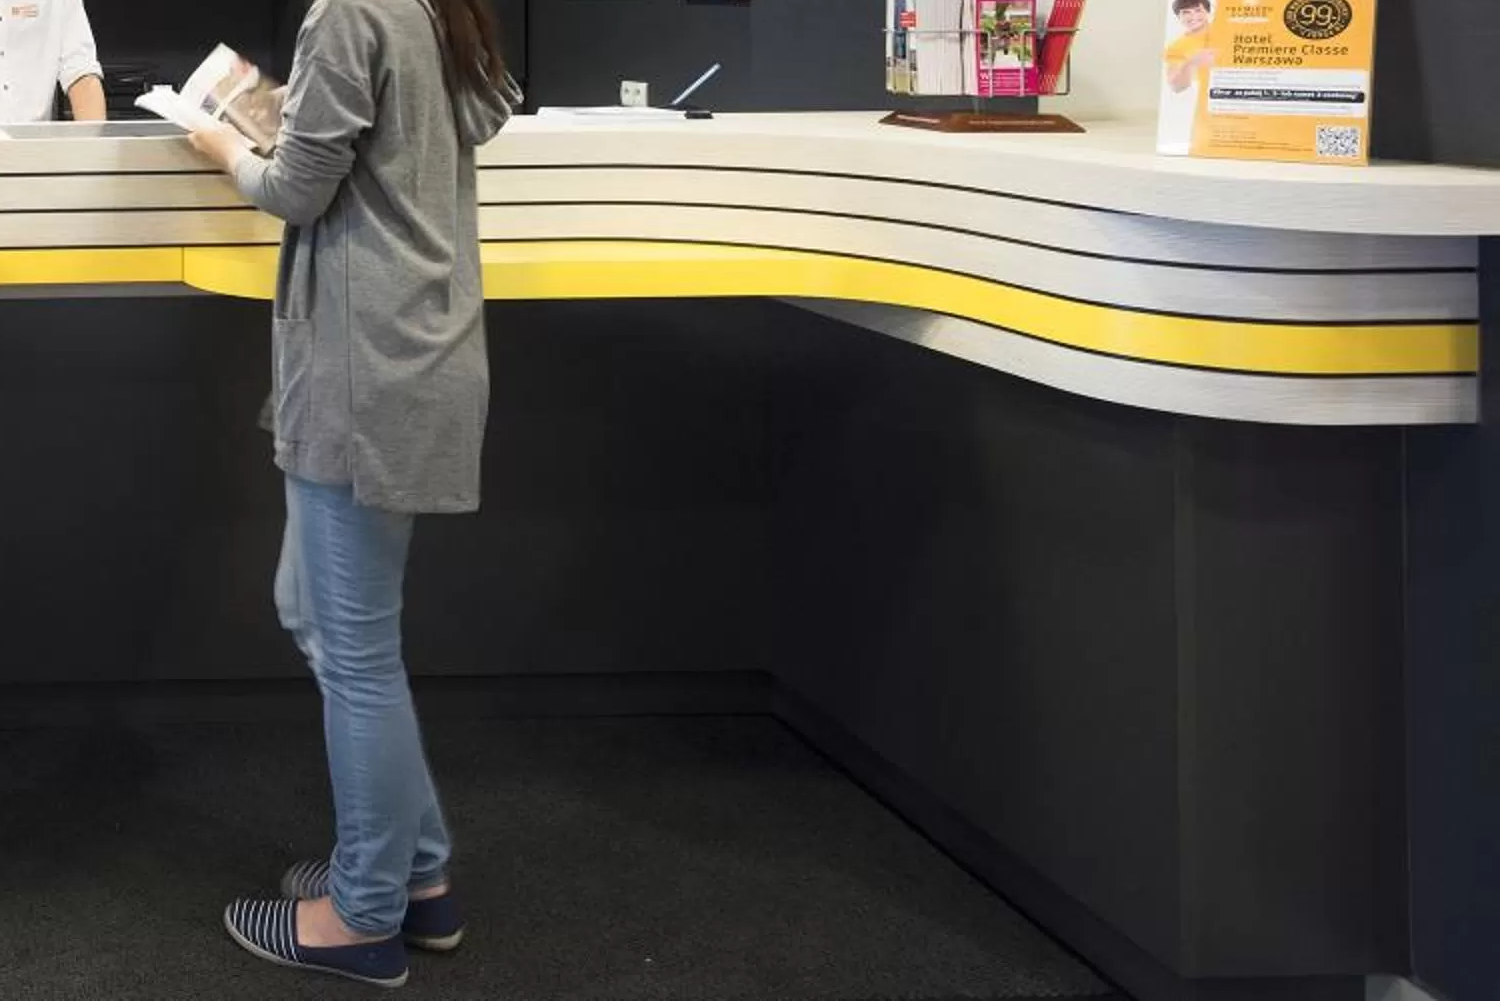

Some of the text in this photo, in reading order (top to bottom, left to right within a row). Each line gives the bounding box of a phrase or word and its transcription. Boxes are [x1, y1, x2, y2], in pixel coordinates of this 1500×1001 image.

[1233, 34, 1272, 44] Hotel
[1233, 44, 1349, 56] Premiere Classe
[1233, 55, 1303, 66] Warszawa
